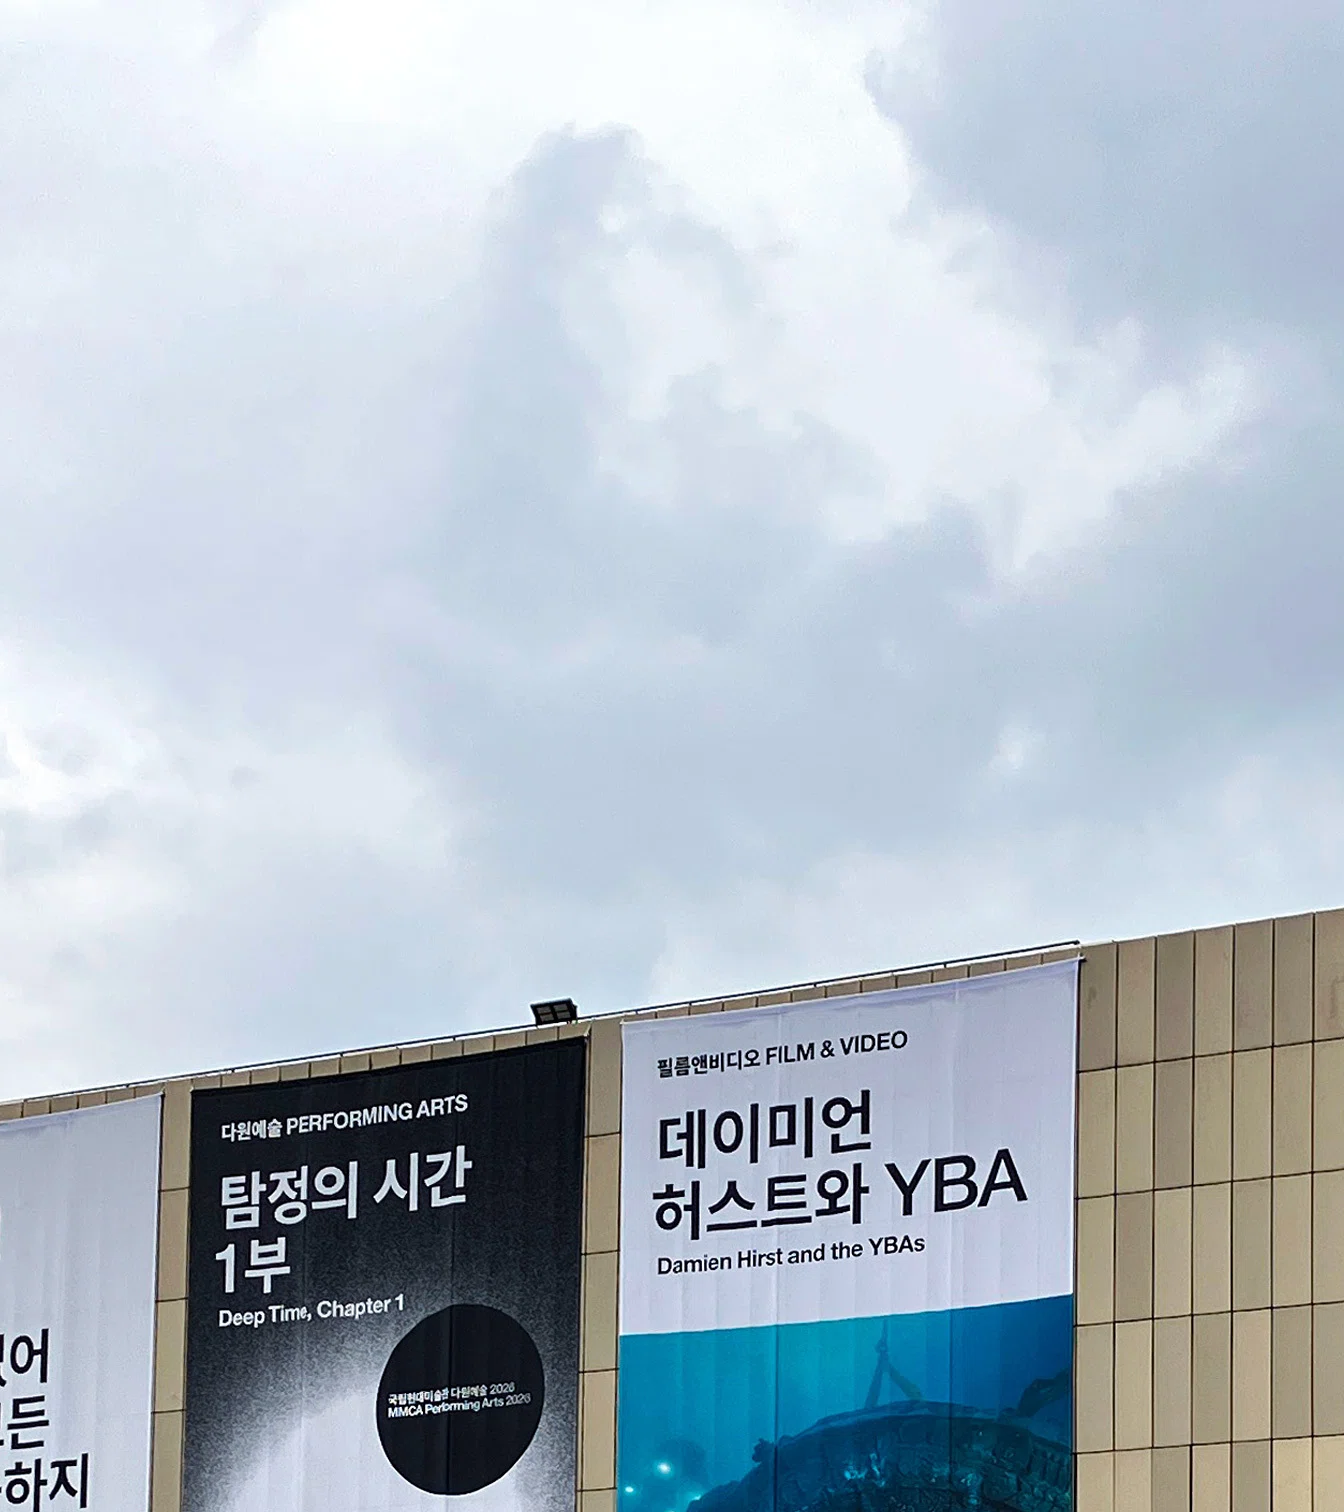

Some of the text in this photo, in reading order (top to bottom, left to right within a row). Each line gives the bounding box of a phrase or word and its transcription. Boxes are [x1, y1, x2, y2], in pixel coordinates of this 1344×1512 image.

[657, 1031, 907, 1078] 필름앤비디오 FILM & VIDEO
[221, 1094, 468, 1142] 다원예술 PERFORMING ARTS
[659, 1089, 871, 1169] 데이미언
[221, 1145, 473, 1230] 탐정의 시간
[652, 1148, 1028, 1240] 허스트와 YBA
[215, 1236, 291, 1293] 1부
[657, 1235, 925, 1275] Damien Hirst and the YBAs
[219, 1293, 404, 1328] Deep Time, Chapter 1
[388, 1406, 423, 1418] MMCA
[482, 1397, 504, 1408] Arts
